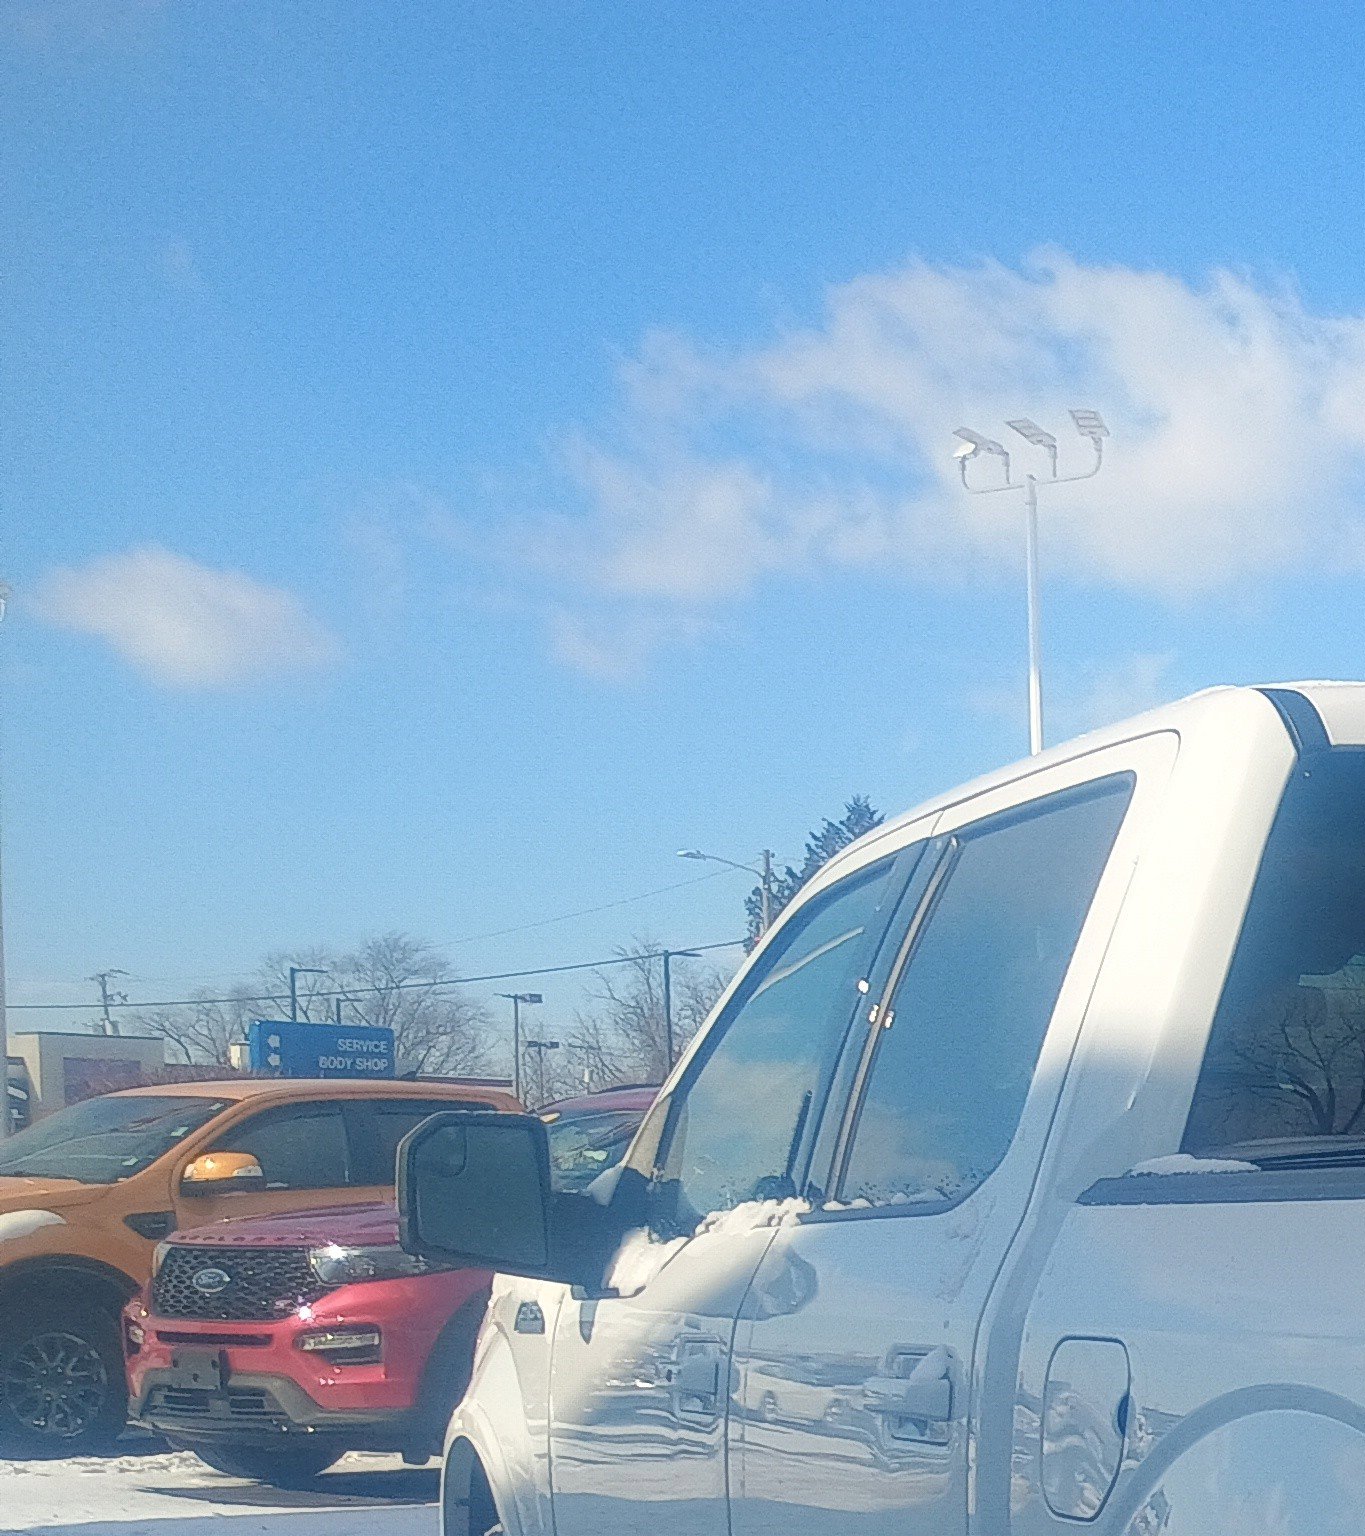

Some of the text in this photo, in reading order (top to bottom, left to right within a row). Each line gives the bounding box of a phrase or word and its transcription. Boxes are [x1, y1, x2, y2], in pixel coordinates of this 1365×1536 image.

[337, 1038, 389, 1053] SERVICE
[318, 1056, 389, 1071] BODY SHOP
